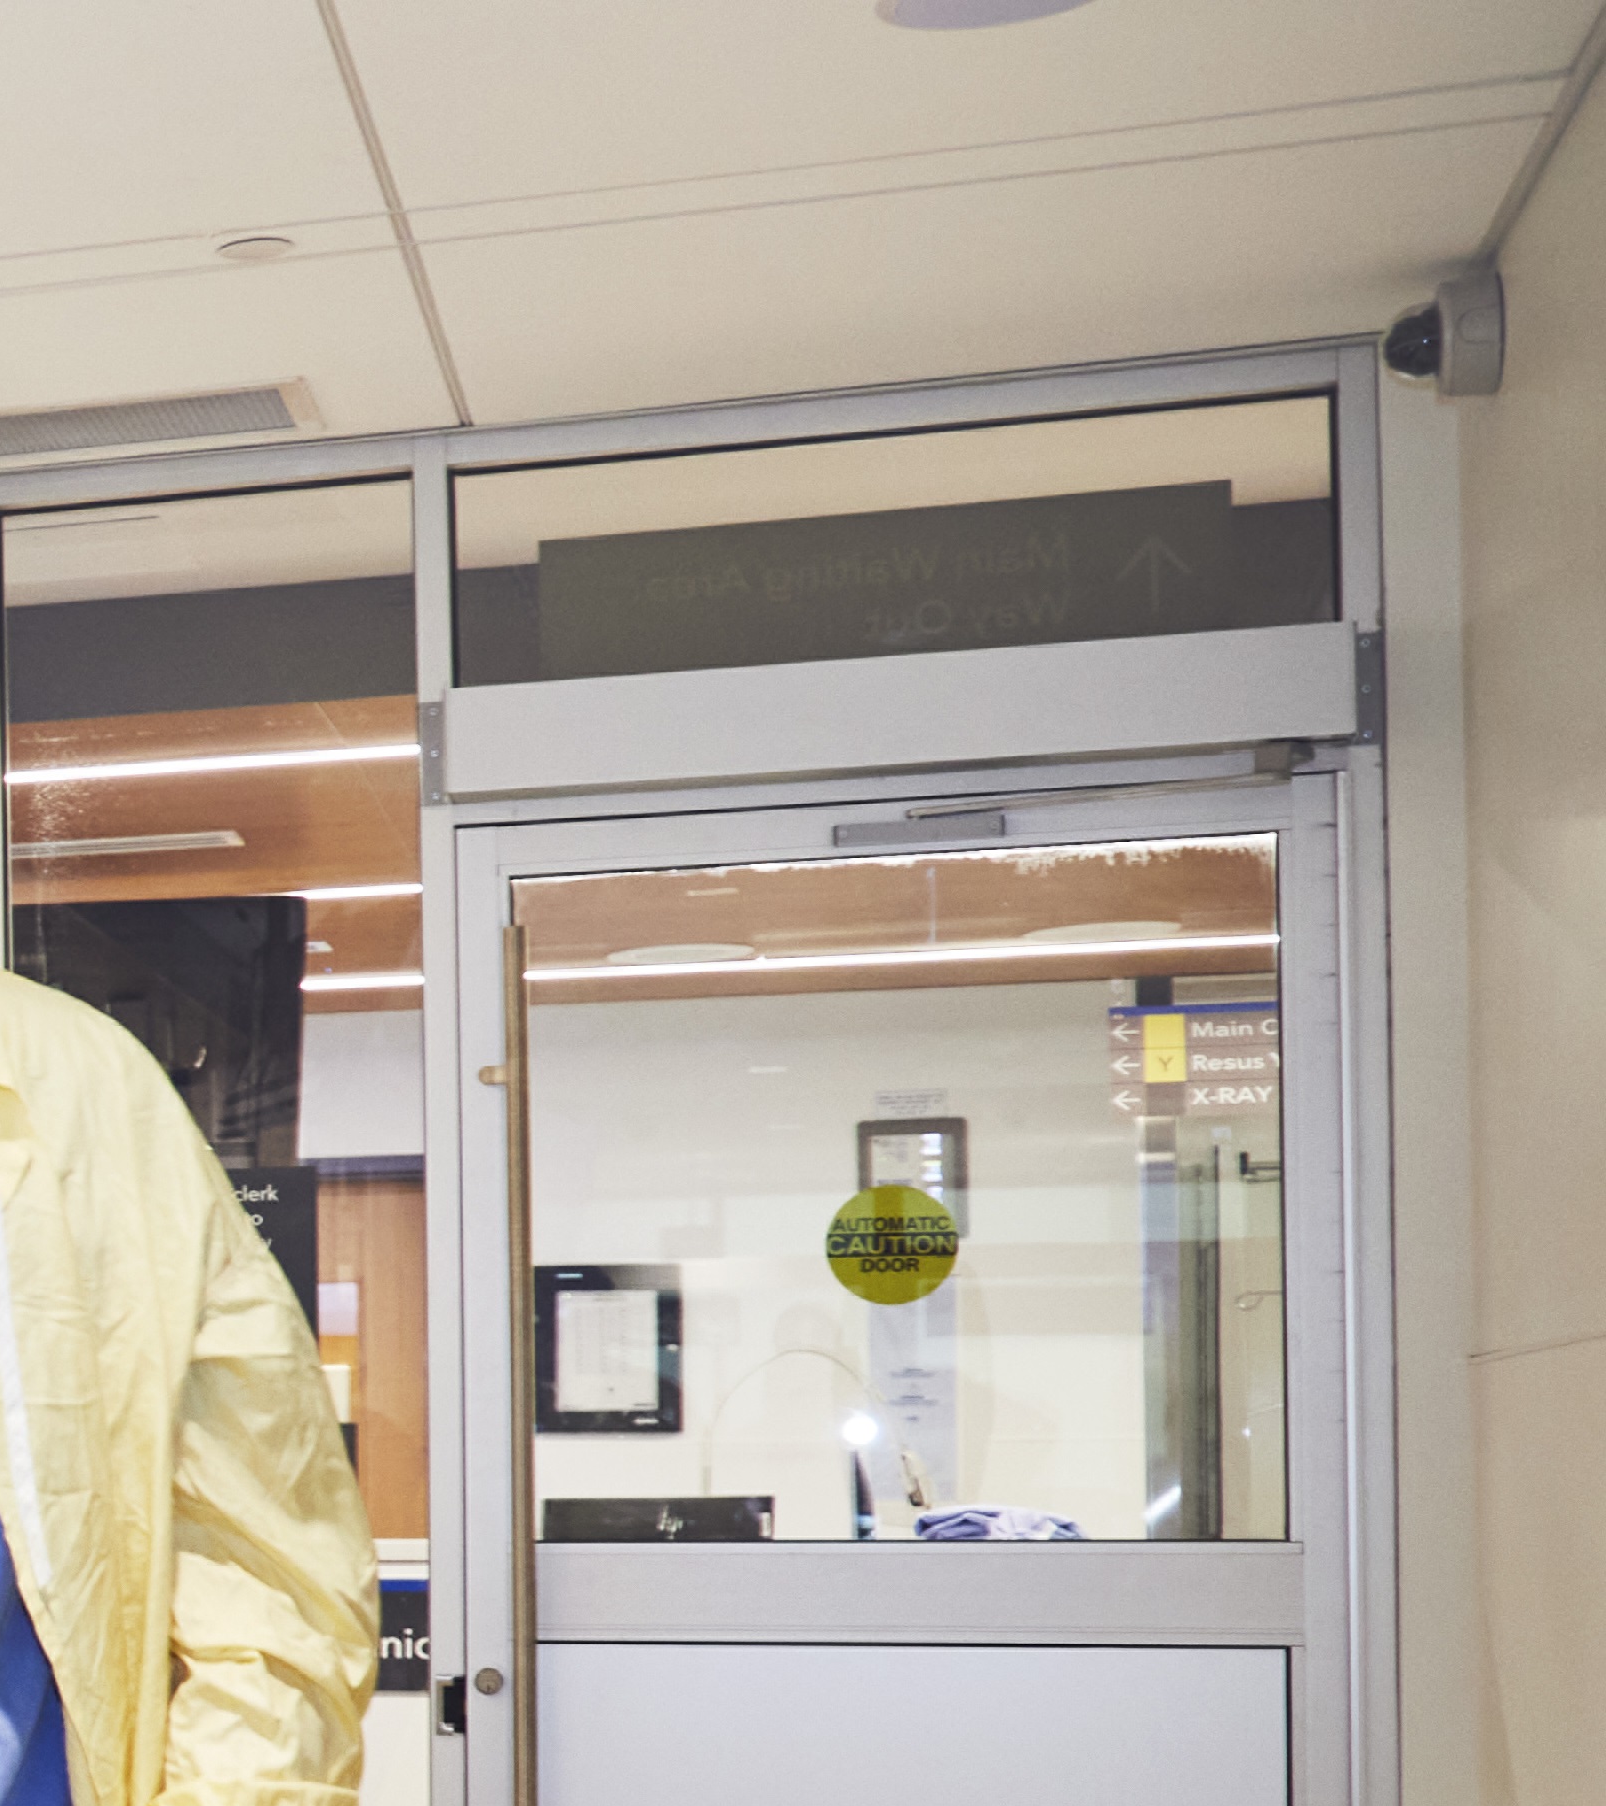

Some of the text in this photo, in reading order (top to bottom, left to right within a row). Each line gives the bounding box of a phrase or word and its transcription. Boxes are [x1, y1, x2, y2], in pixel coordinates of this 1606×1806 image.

[1191, 1021, 1254, 1037] Main
[1192, 1054, 1264, 1071] Resus
[1192, 1086, 1273, 1105] X-RAY
[835, 1216, 951, 1232] AUTOMATIC
[828, 1235, 957, 1256] CAUTION
[860, 1257, 920, 1273] DOOR
